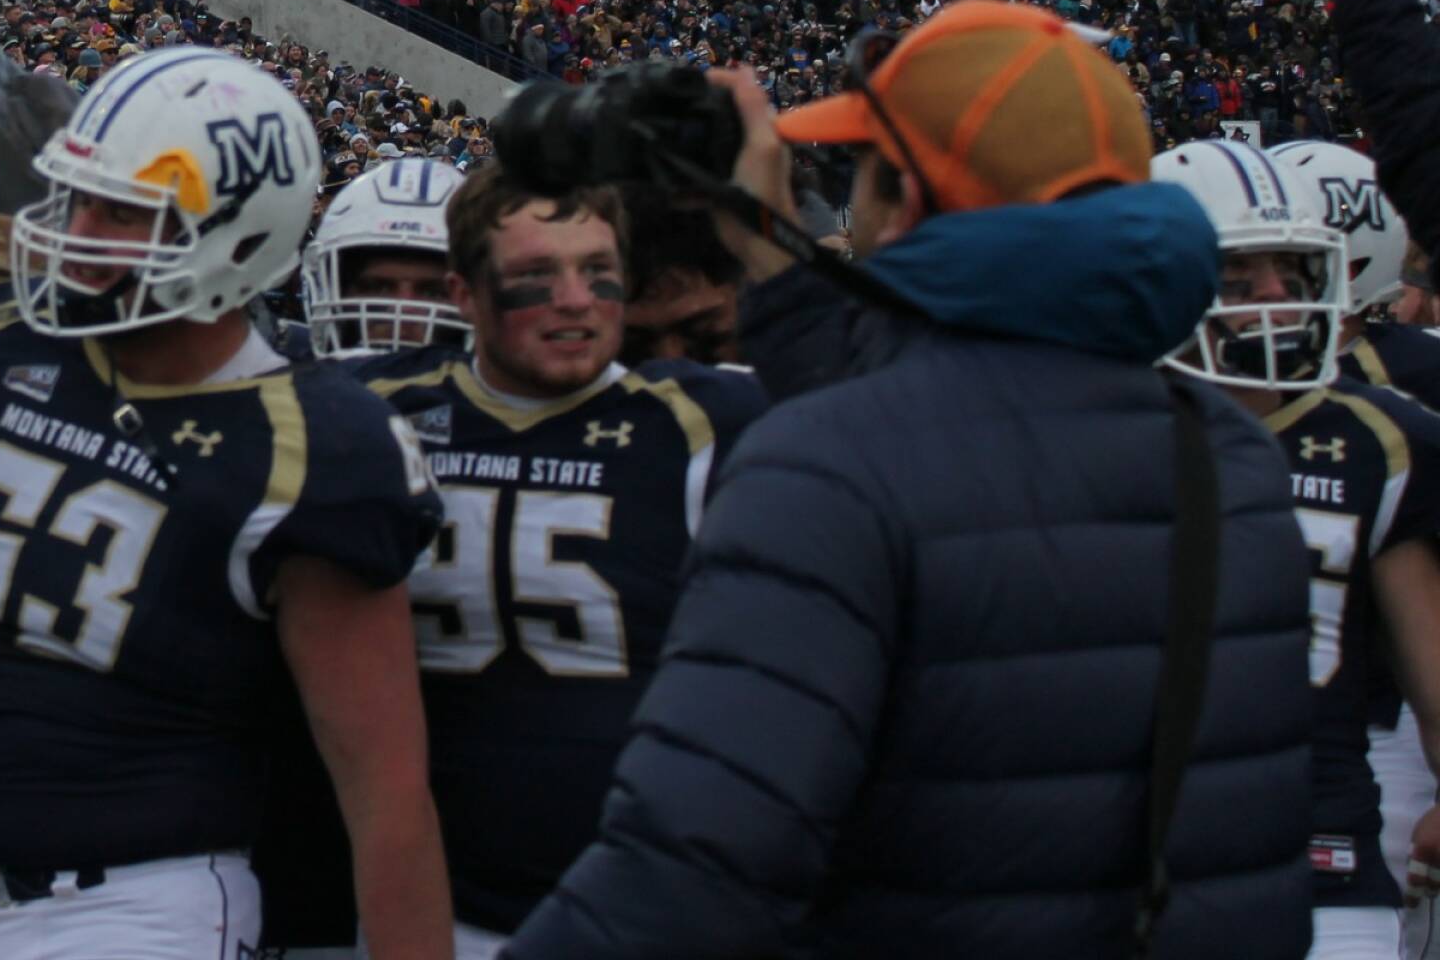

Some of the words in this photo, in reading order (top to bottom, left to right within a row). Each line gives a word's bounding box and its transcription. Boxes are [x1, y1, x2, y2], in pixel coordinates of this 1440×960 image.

[207, 112, 295, 194] M
[1319, 177, 1385, 231] M
[529, 456, 605, 487] STATE
[1290, 473, 1346, 504] TATE
[410, 485, 630, 677] 95
